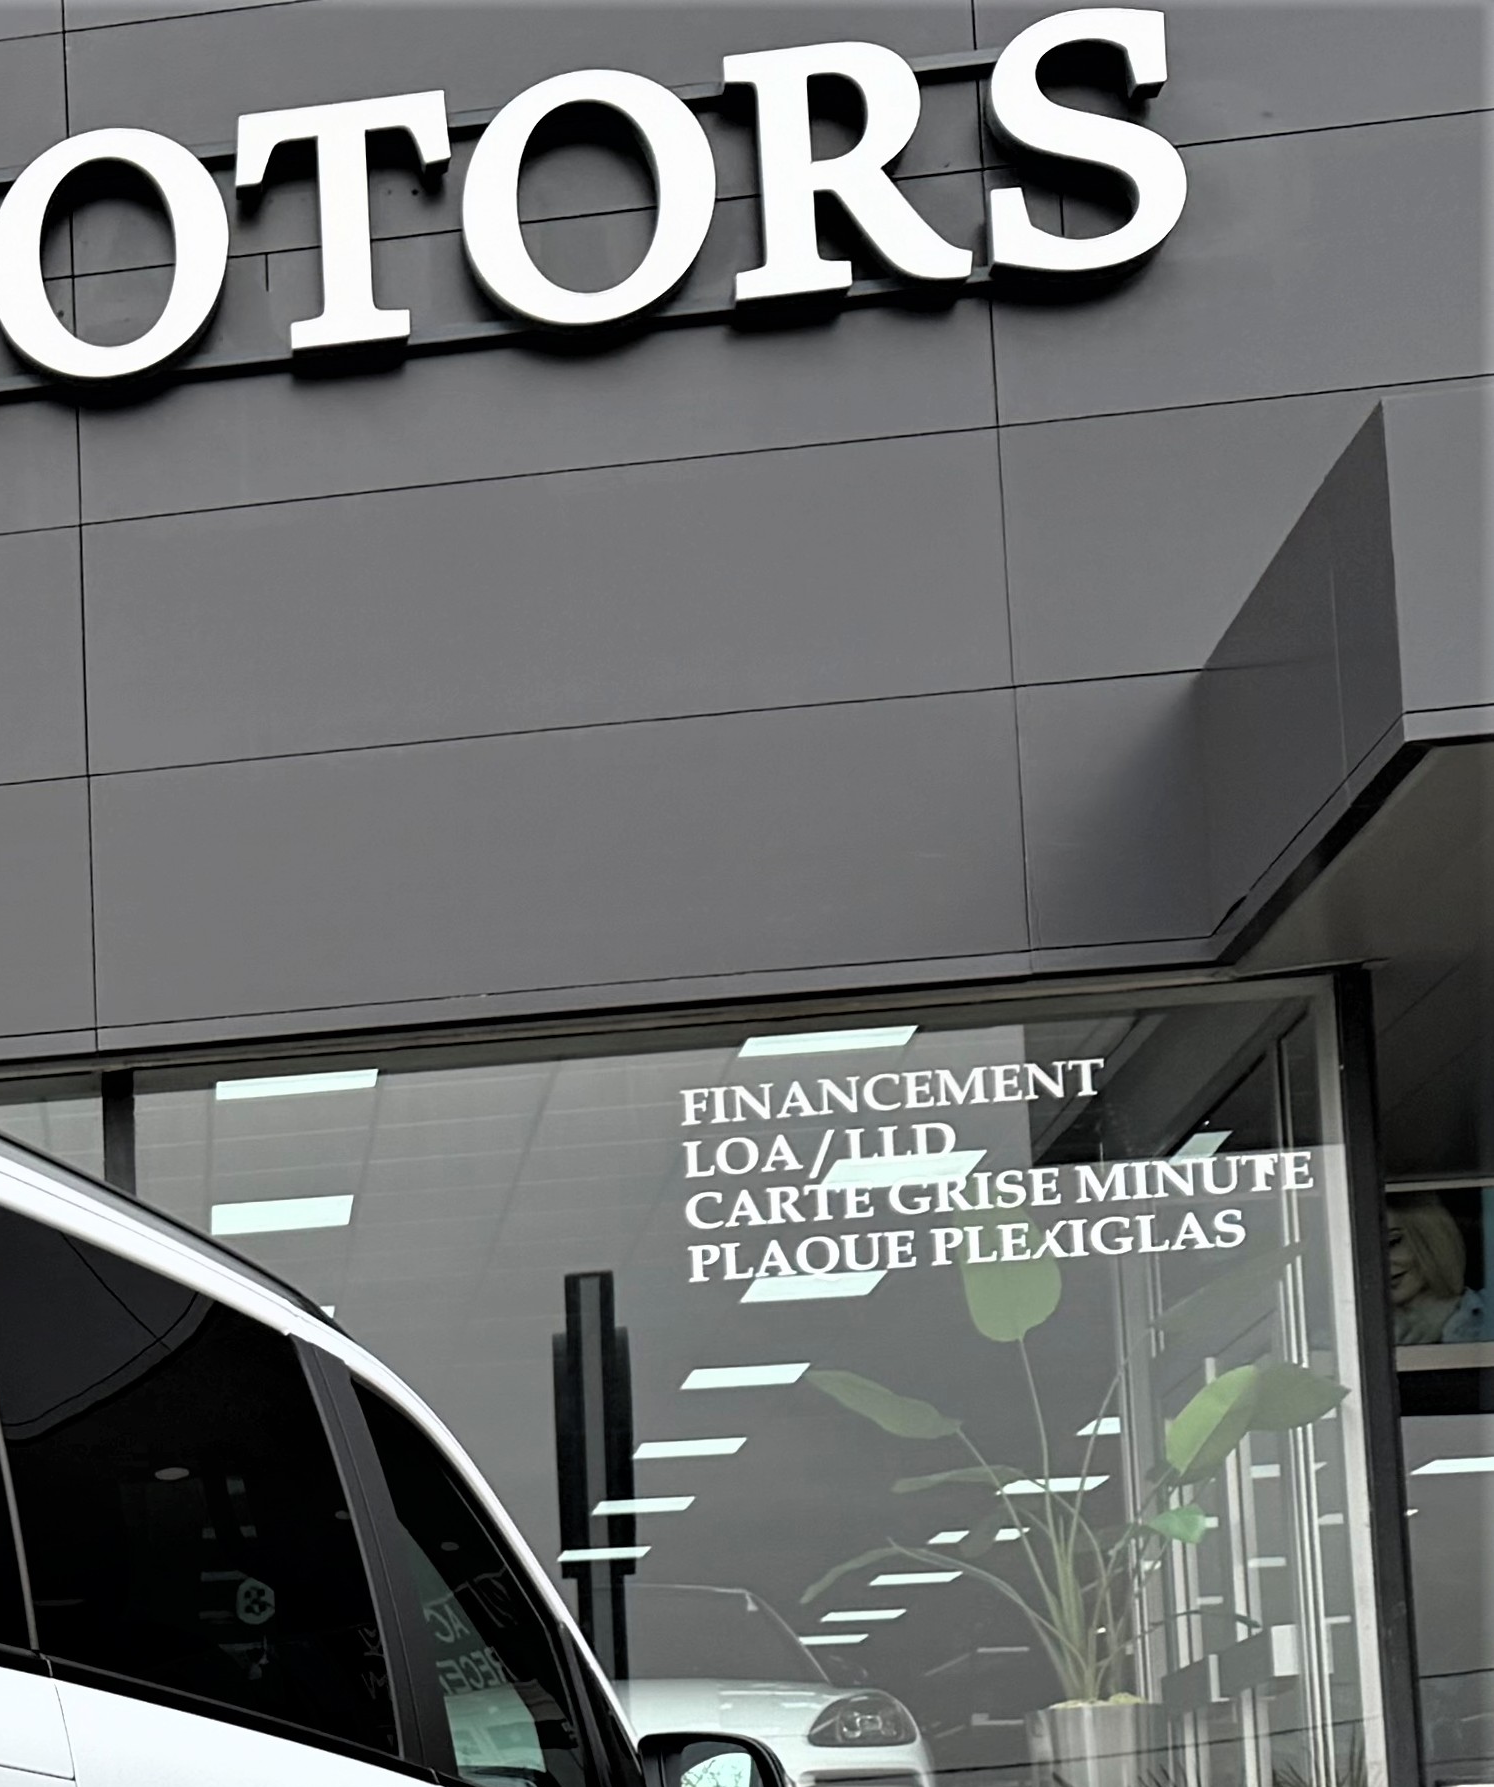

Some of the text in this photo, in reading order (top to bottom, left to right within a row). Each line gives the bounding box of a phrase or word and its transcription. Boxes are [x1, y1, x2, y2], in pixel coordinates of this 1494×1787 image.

[679, 1058, 1105, 1126] FINANCEMENT
[684, 1151, 1315, 1231] CARTE GRISE MINUTE
[687, 1208, 1247, 1284] PLAQUE PLEXIGLAS
